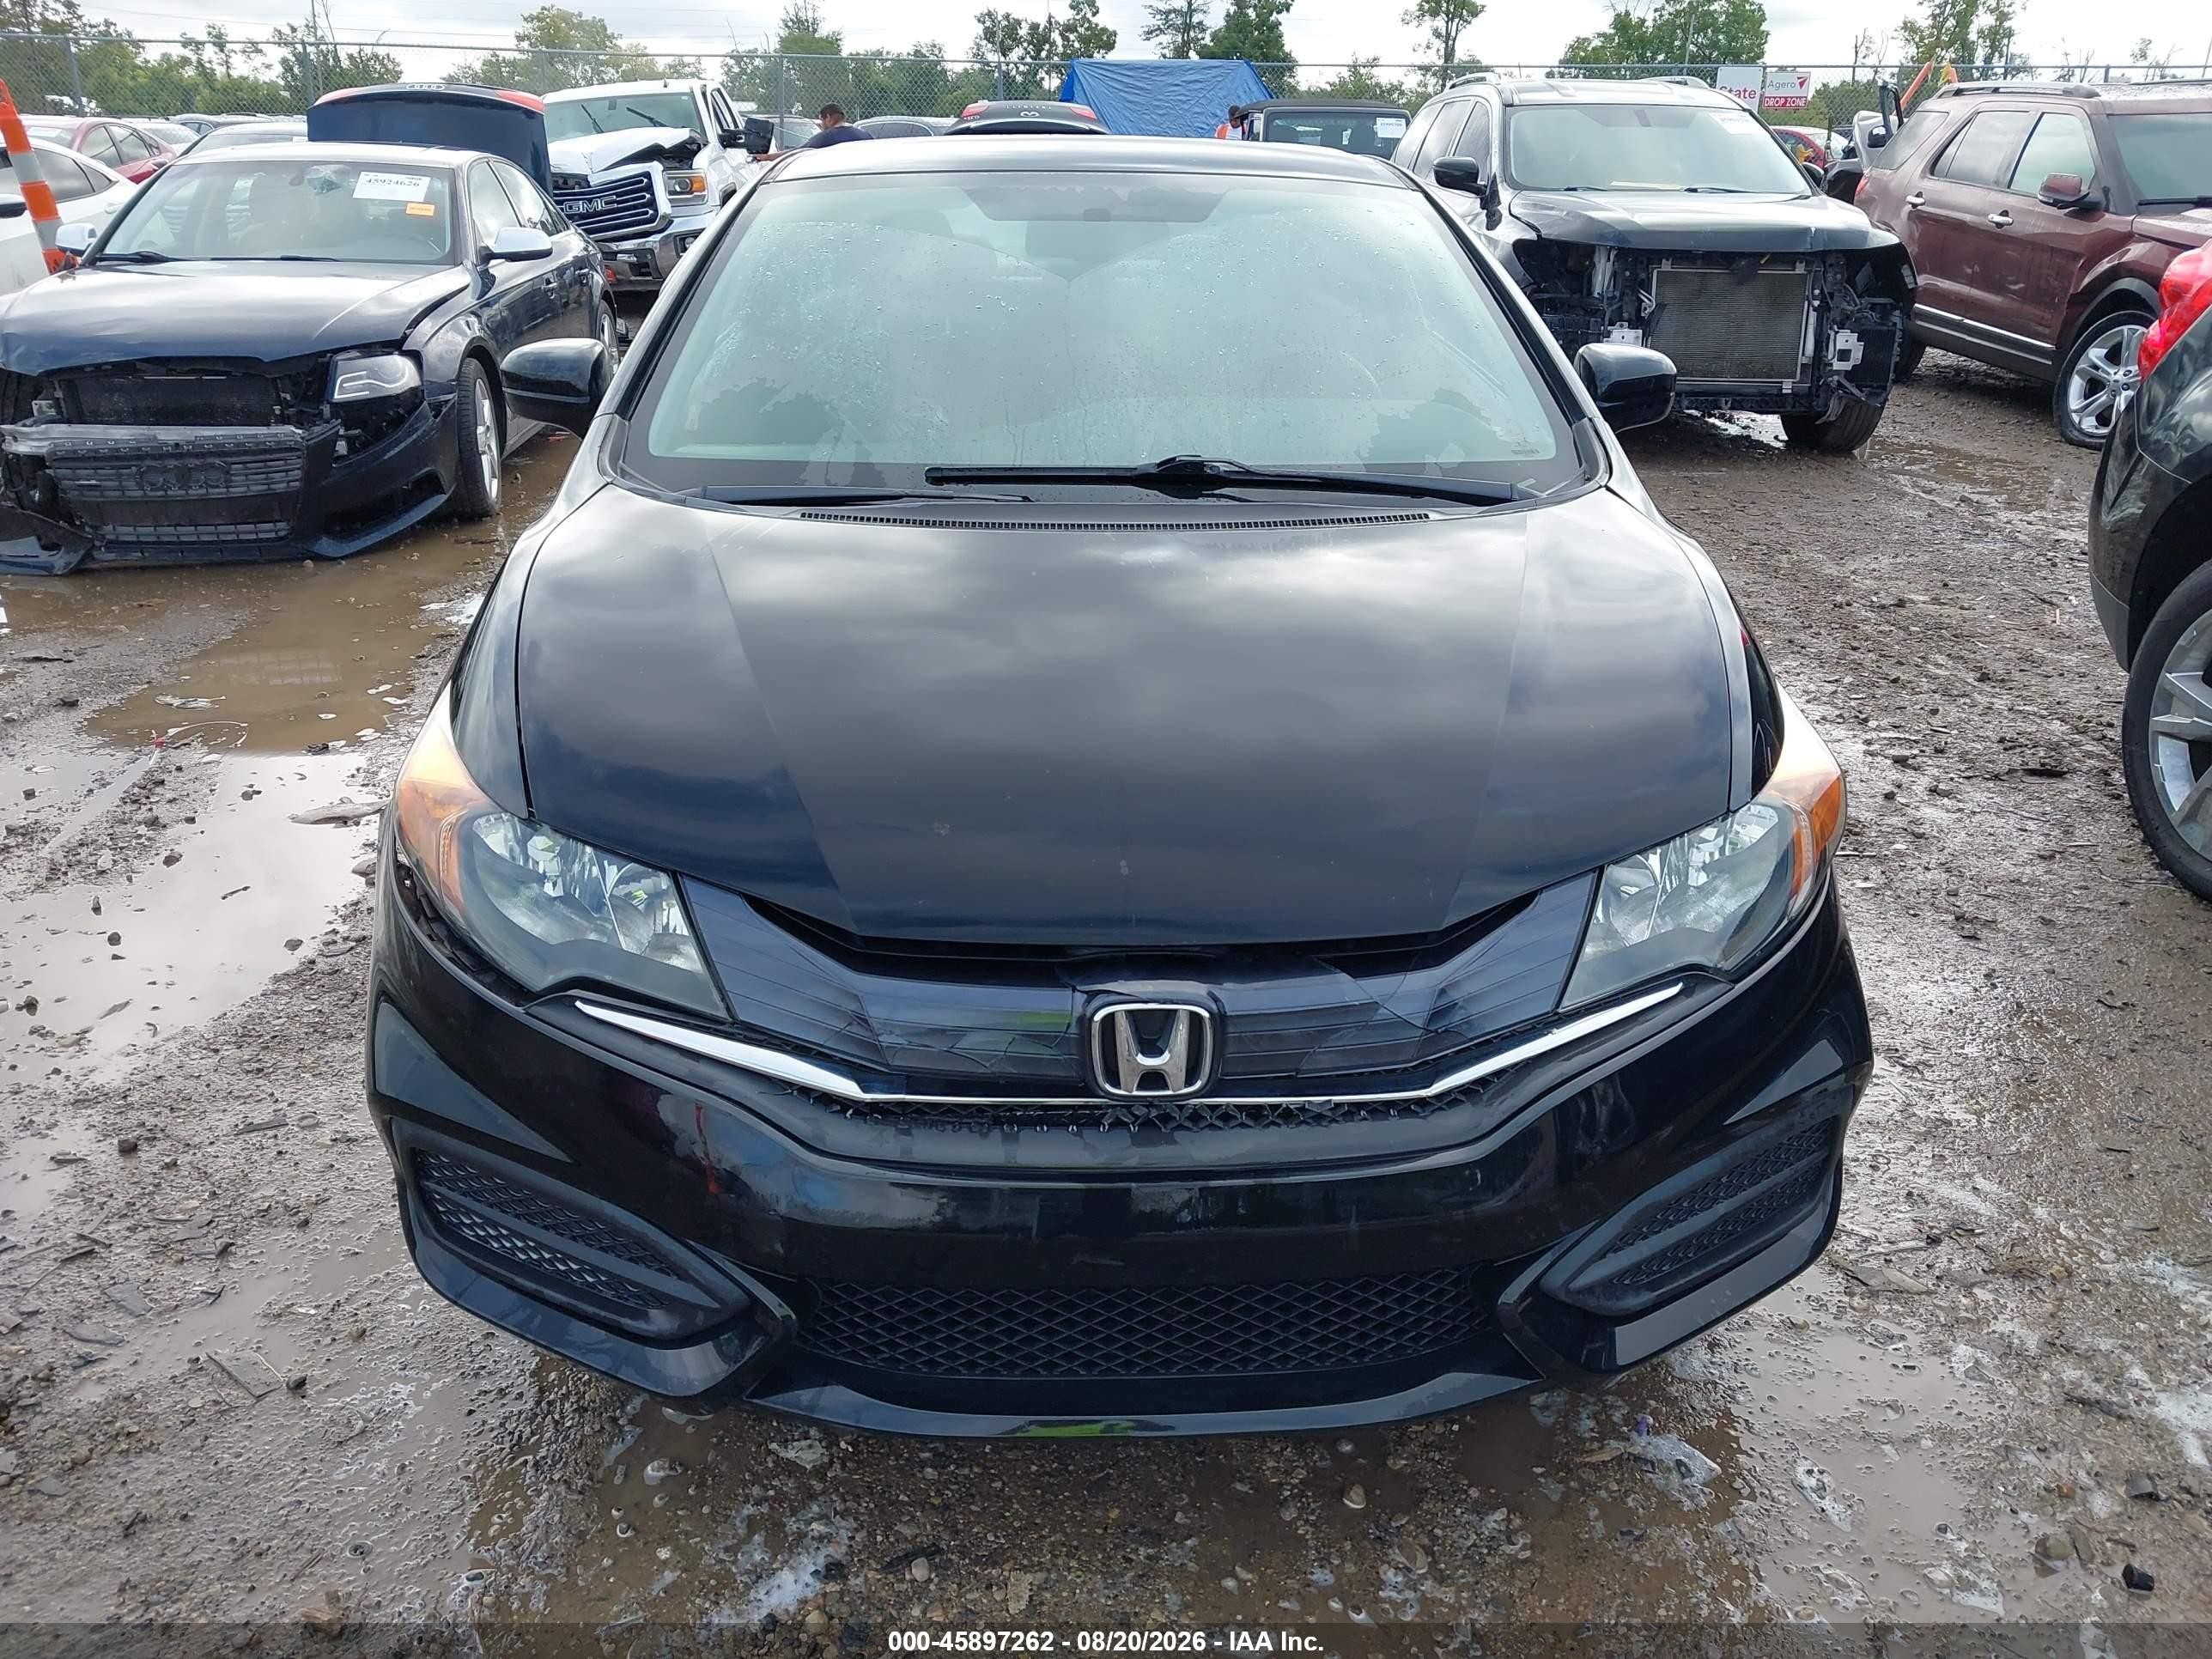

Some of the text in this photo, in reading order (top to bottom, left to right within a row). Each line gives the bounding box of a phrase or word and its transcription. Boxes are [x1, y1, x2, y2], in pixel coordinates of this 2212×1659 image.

[1768, 80, 1796, 90] Agero
[1719, 86, 1757, 99] tate
[1765, 97, 1807, 106] DROP ZONE
[562, 195, 617, 215] GMC
